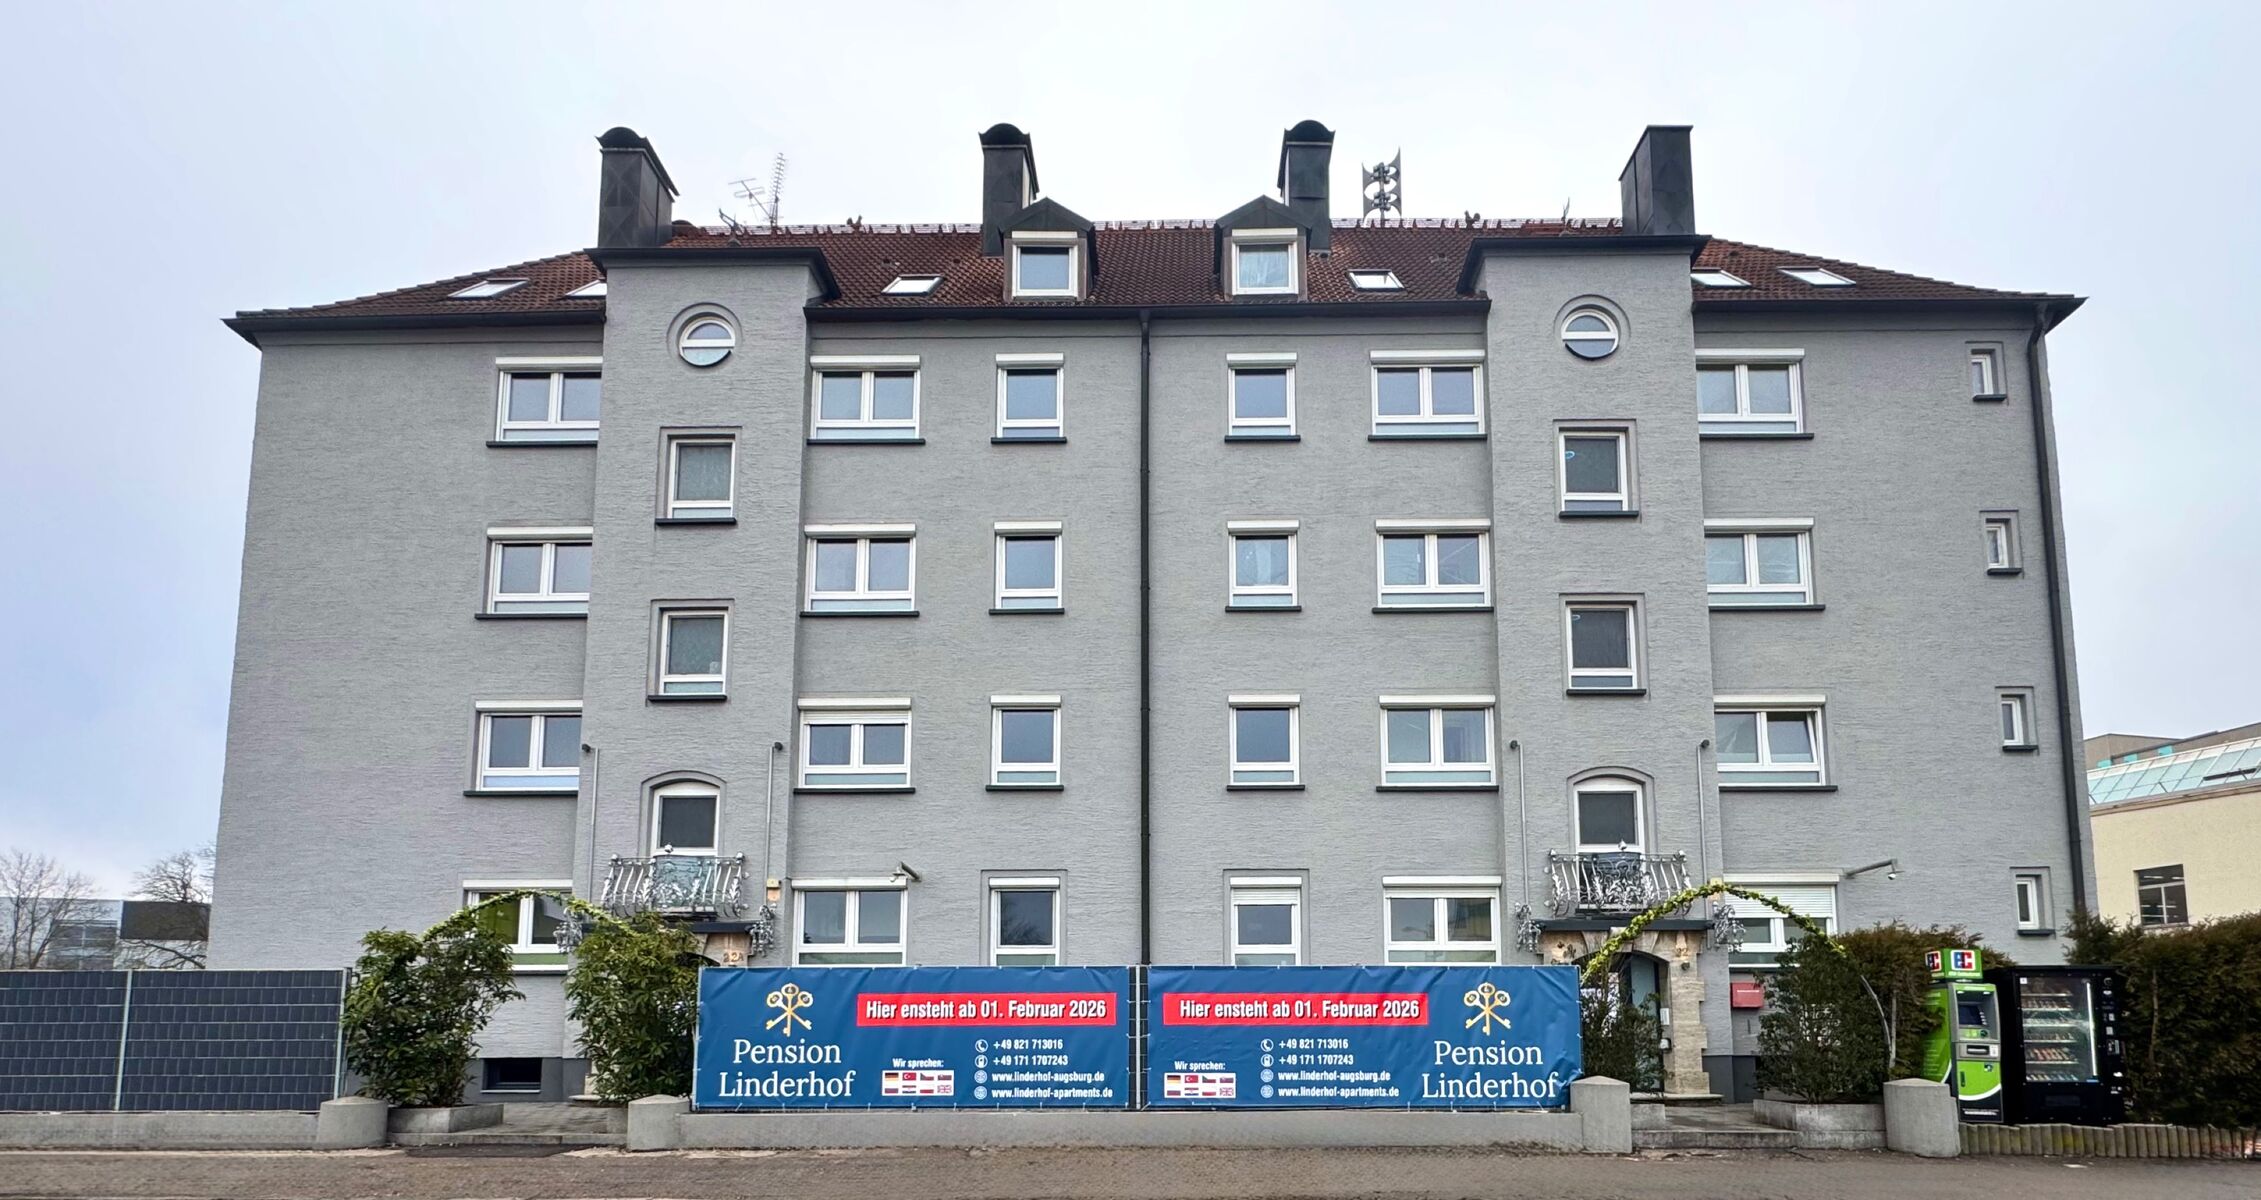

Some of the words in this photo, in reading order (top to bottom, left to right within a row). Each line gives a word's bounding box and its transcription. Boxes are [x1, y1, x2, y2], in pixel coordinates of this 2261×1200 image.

[866, 1000, 897, 1018] Hier
[901, 1001, 954, 1018] ensteht
[959, 1000, 976, 1018] ab
[981, 1000, 1003, 1018] 01.
[1008, 1000, 1065, 1018] Februar
[1069, 1000, 1106, 1018] 2026
[1180, 1000, 1210, 1018] Hier
[1215, 1000, 1268, 1018] ensteht
[1272, 1000, 1290, 1018] ab
[1295, 1000, 1318, 1018] 01.
[1322, 1000, 1379, 1018] Februar
[1383, 1000, 1420, 1018] 2026
[993, 1039, 1011, 1050] +49
[1013, 1039, 1029, 1050] 821
[1032, 1039, 1063, 1050] 713016
[1279, 1039, 1297, 1050] +49
[1299, 1039, 1315, 1050] 821
[1317, 1039, 1349, 1050] 713016
[733, 1038, 842, 1064] Pension
[1434, 1039, 1544, 1065] Pension
[892, 1058, 906, 1067] Wir
[908, 1058, 944, 1069] sprechen:
[993, 1055, 1011, 1066] +49
[1013, 1055, 1029, 1066] 171
[1032, 1055, 1068, 1066] 1707243
[1279, 1055, 1297, 1065] +49
[1299, 1055, 1315, 1065] 171
[1317, 1055, 1354, 1065] 1707243
[1174, 1061, 1188, 1070] Wir
[1189, 1061, 1226, 1072] sprechen:
[992, 1071, 1105, 1083] www.linderhof-augsburg.de
[1278, 1070, 1391, 1083] www.linderhof-augsburg.de
[718, 1070, 857, 1098] Linderhof
[1421, 1071, 1559, 1098] Linderhof
[991, 1087, 1113, 1099] www.linderhof-apartments.de
[1278, 1086, 1399, 1099] www.linderhof-apartments.de
